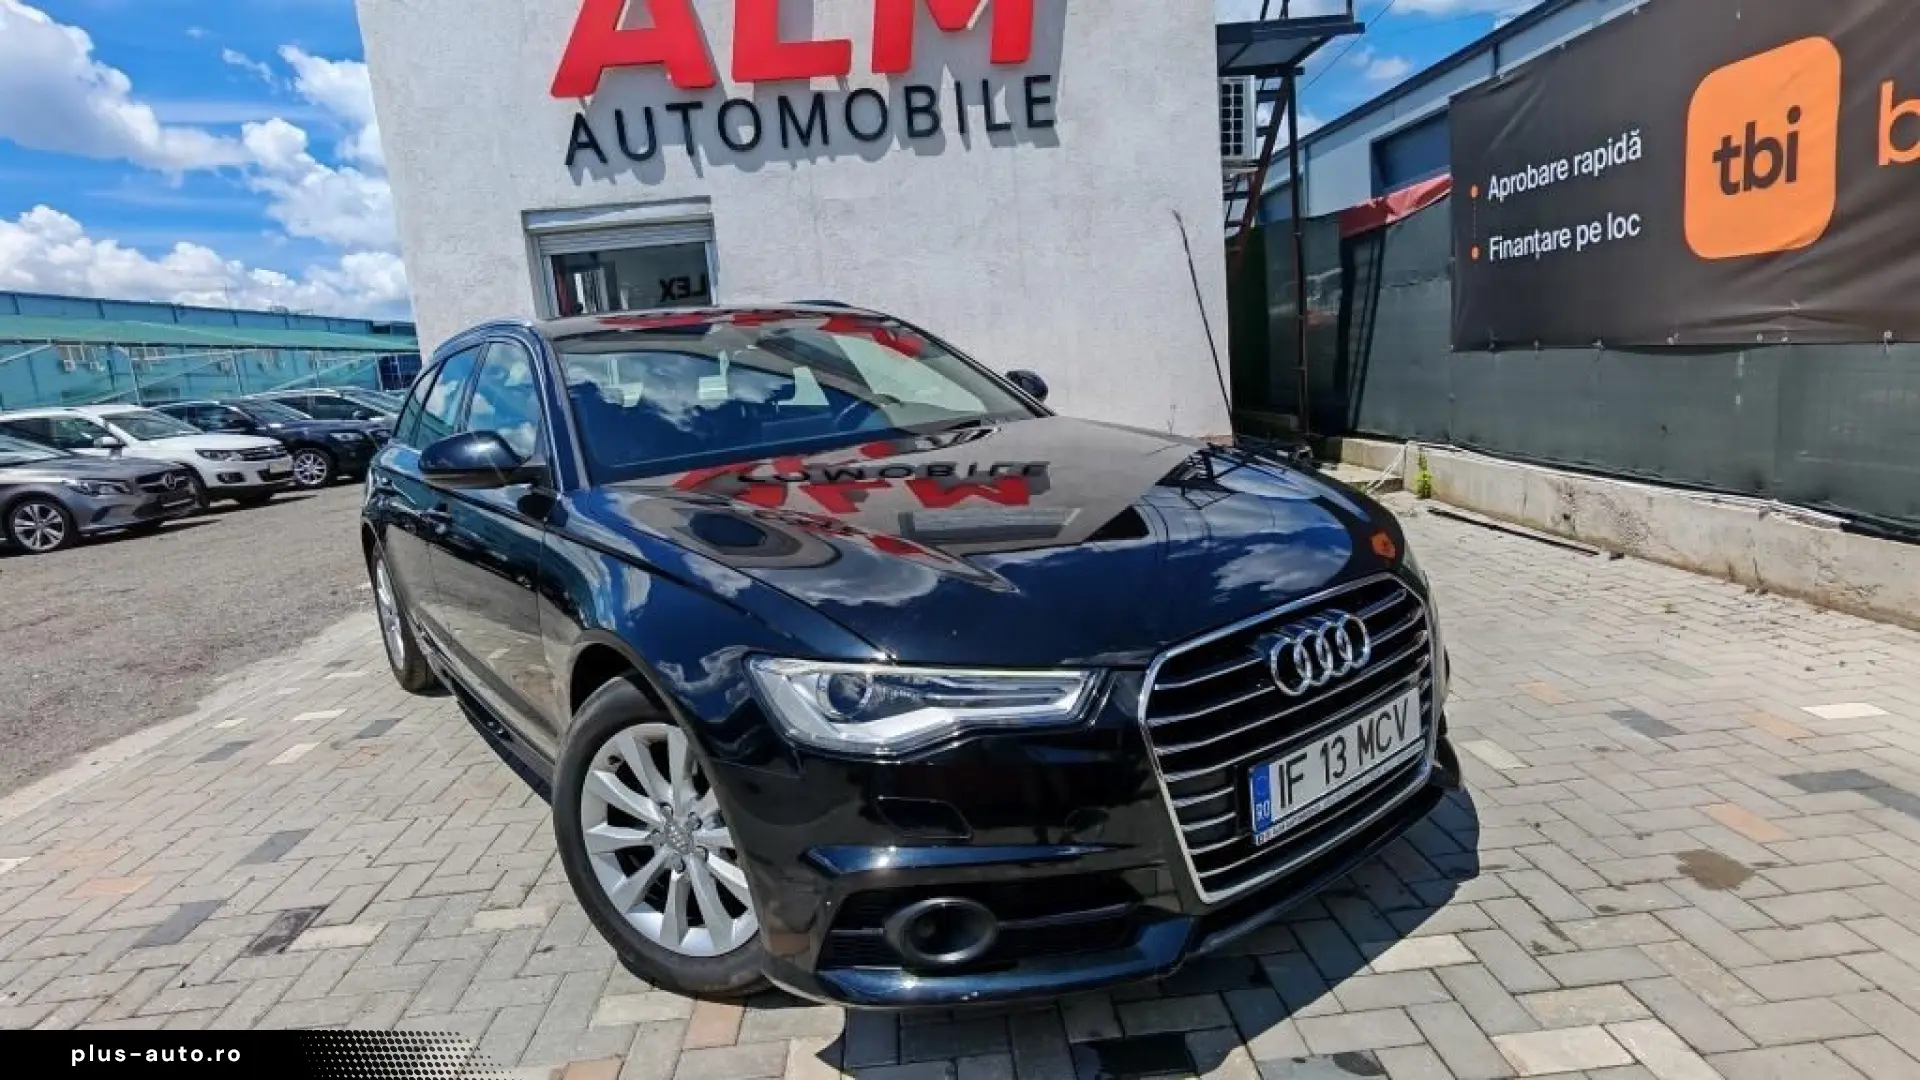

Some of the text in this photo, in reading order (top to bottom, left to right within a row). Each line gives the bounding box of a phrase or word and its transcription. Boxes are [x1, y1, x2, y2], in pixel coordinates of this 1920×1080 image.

[551, 0, 1035, 97] ALM
[565, 75, 1054, 166] AUTOMOBILE
[1488, 129, 1642, 202] Aprobare rapidă
[1712, 105, 1801, 195] tbi
[1489, 212, 1641, 262] Finanțare pe loc
[1278, 752, 1307, 808] IF
[1320, 735, 1346, 784] 13
[1357, 698, 1408, 766] MCV
